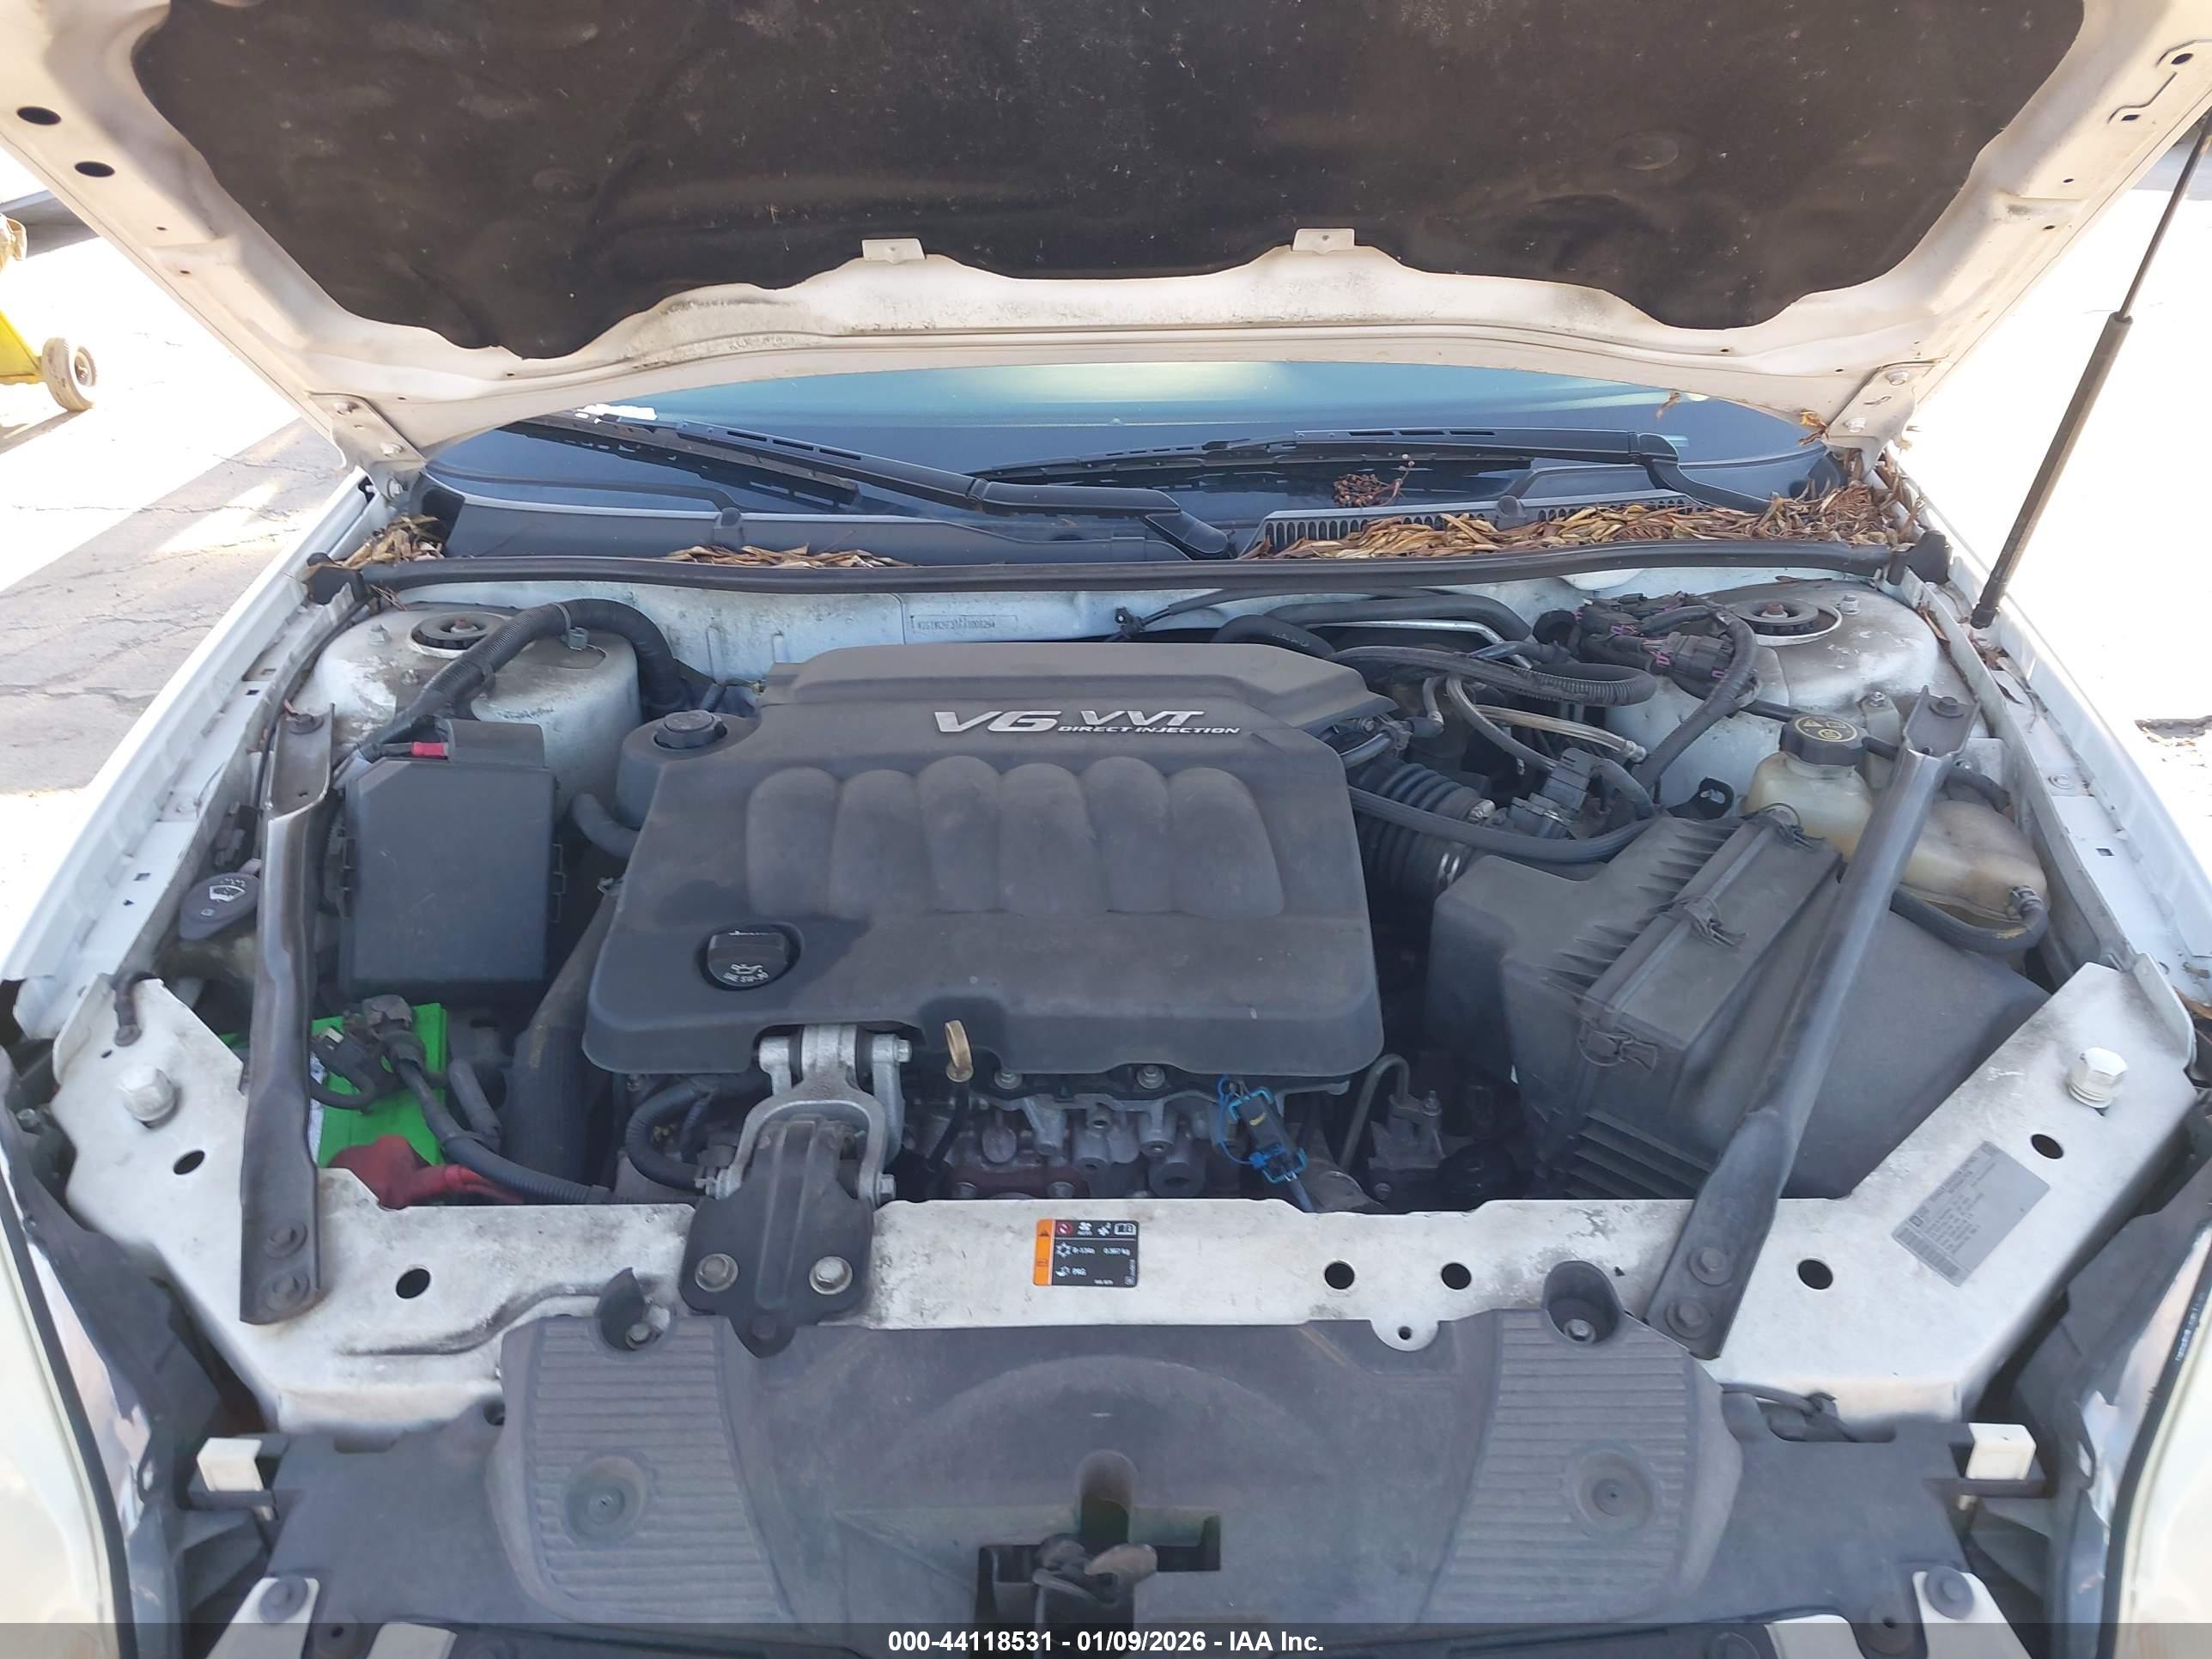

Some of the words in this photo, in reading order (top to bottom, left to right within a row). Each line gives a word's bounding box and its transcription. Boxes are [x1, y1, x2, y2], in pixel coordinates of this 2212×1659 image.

[934, 710, 1062, 733] V6
[1079, 710, 1205, 726] VVT
[1134, 726, 1242, 734] INJECTION
